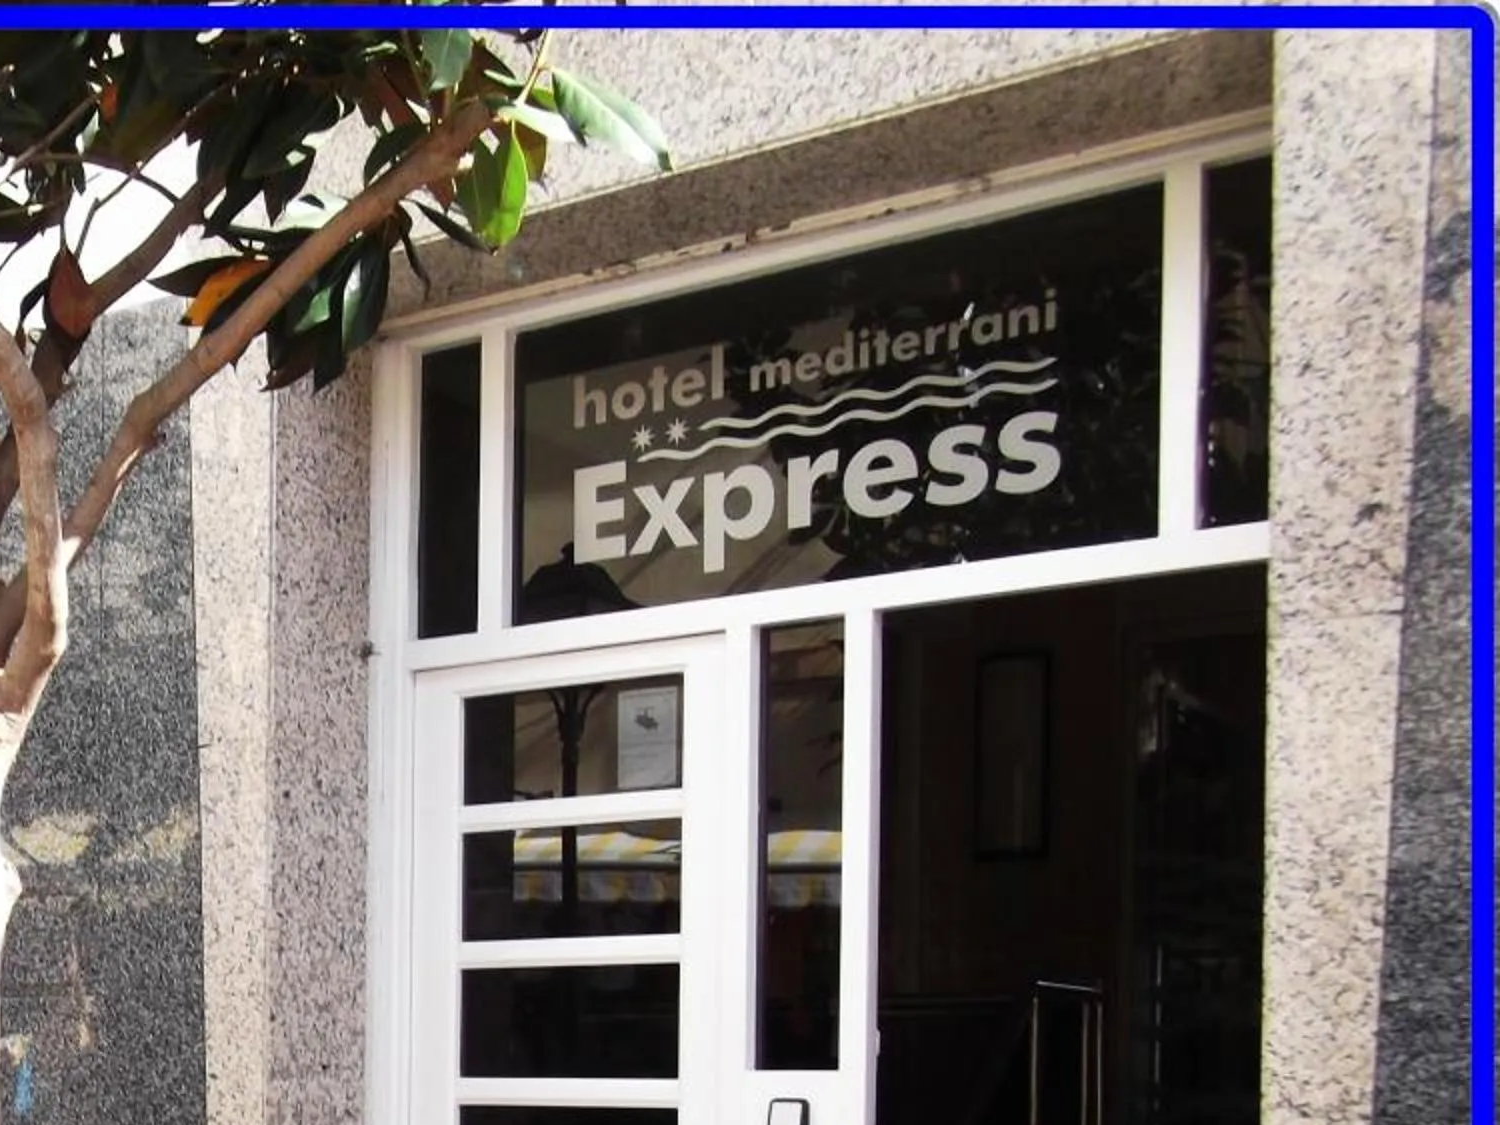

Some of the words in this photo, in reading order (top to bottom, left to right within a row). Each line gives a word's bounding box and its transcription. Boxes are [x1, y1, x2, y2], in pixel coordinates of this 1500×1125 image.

[573, 344, 725, 430] hotel
[749, 289, 1058, 393] mediterrani
[573, 410, 1062, 575] Express
